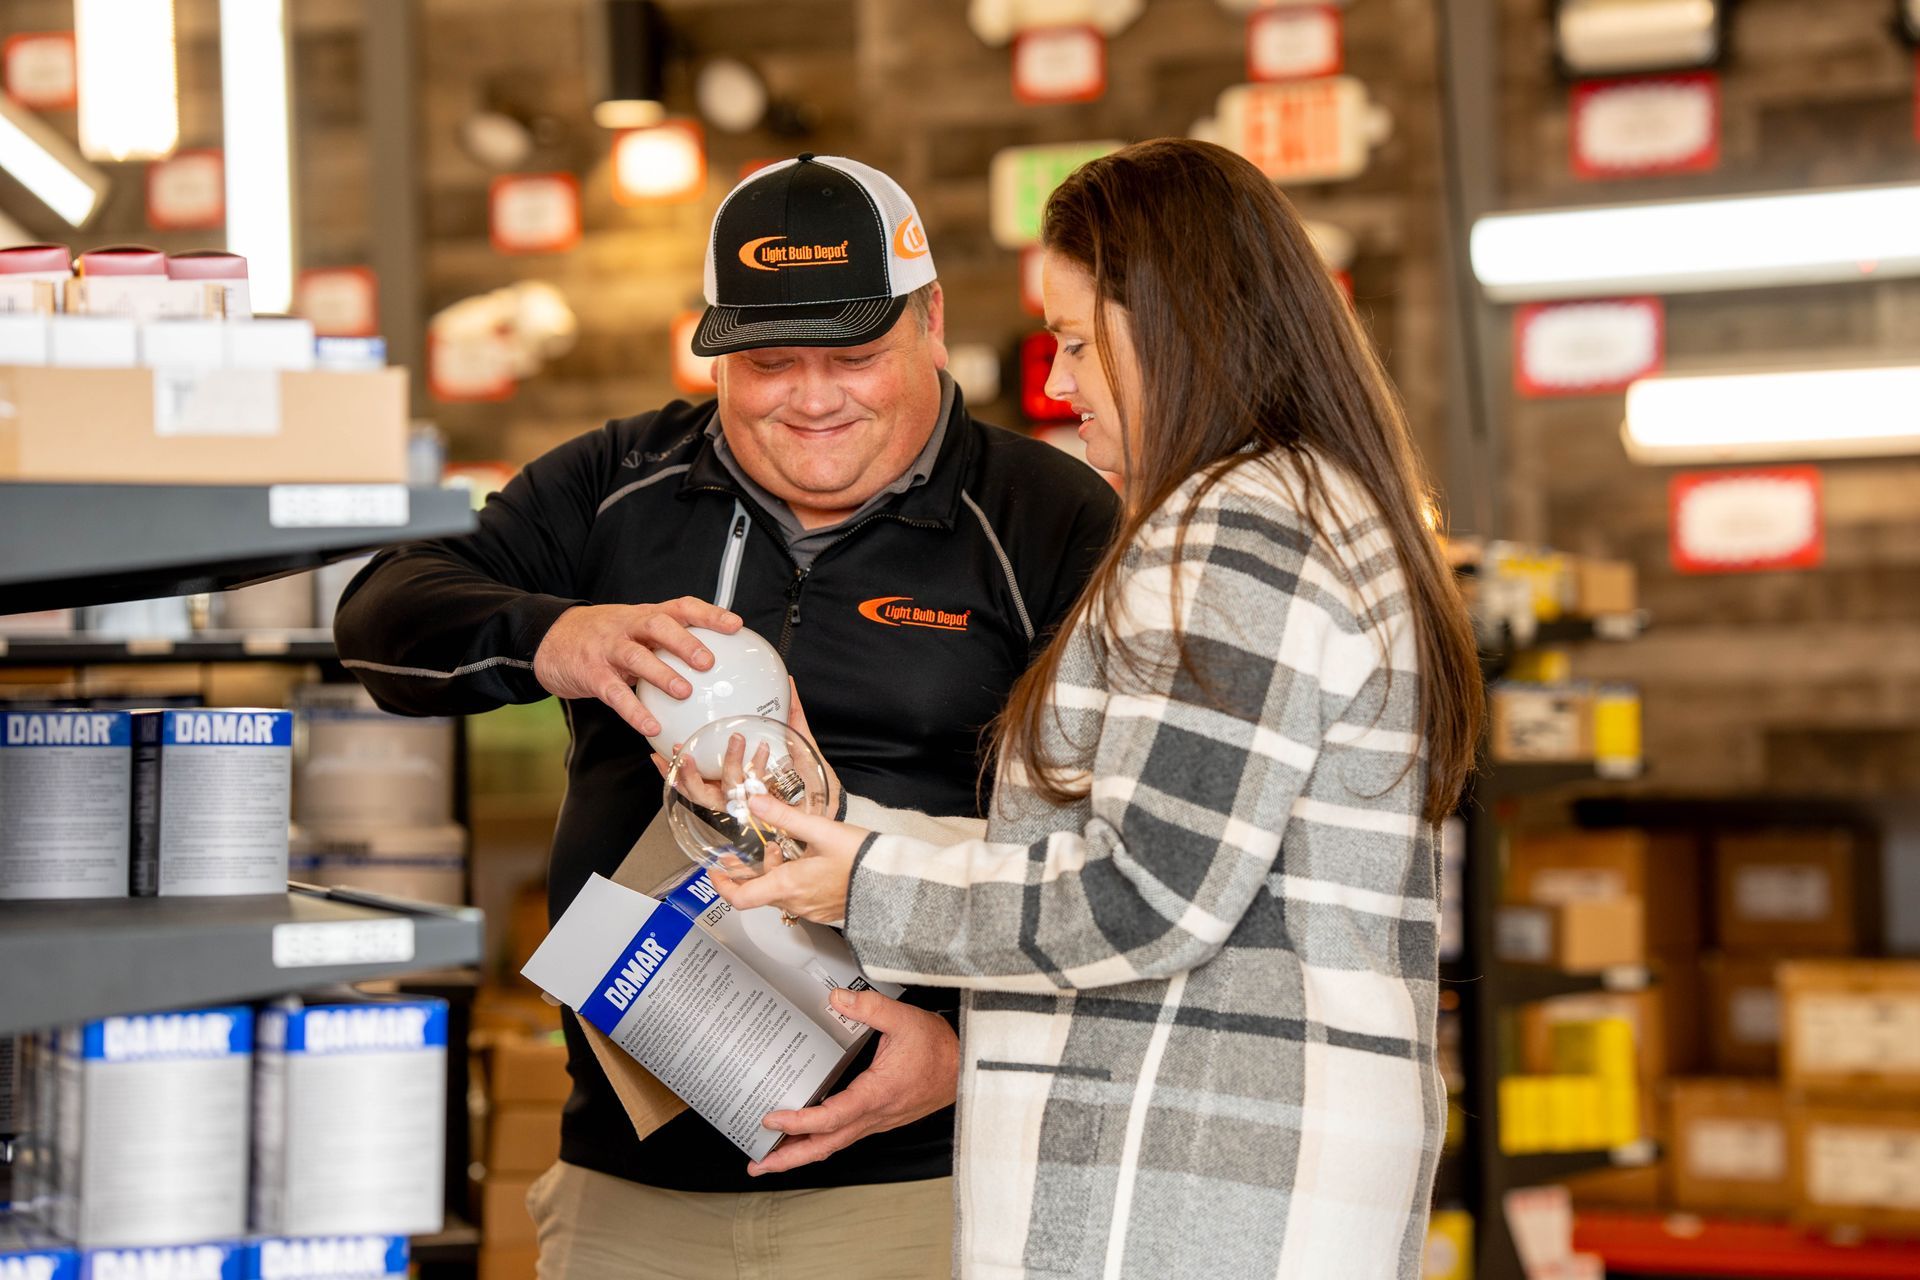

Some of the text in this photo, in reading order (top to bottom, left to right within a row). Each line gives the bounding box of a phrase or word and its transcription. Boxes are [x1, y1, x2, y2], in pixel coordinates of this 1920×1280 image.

[762, 244, 847, 263] Light Bulb Depot
[884, 605, 968, 627] Light Bulb Depot
[7, 714, 111, 745] DAMAR
[175, 714, 274, 744] DAMAR
